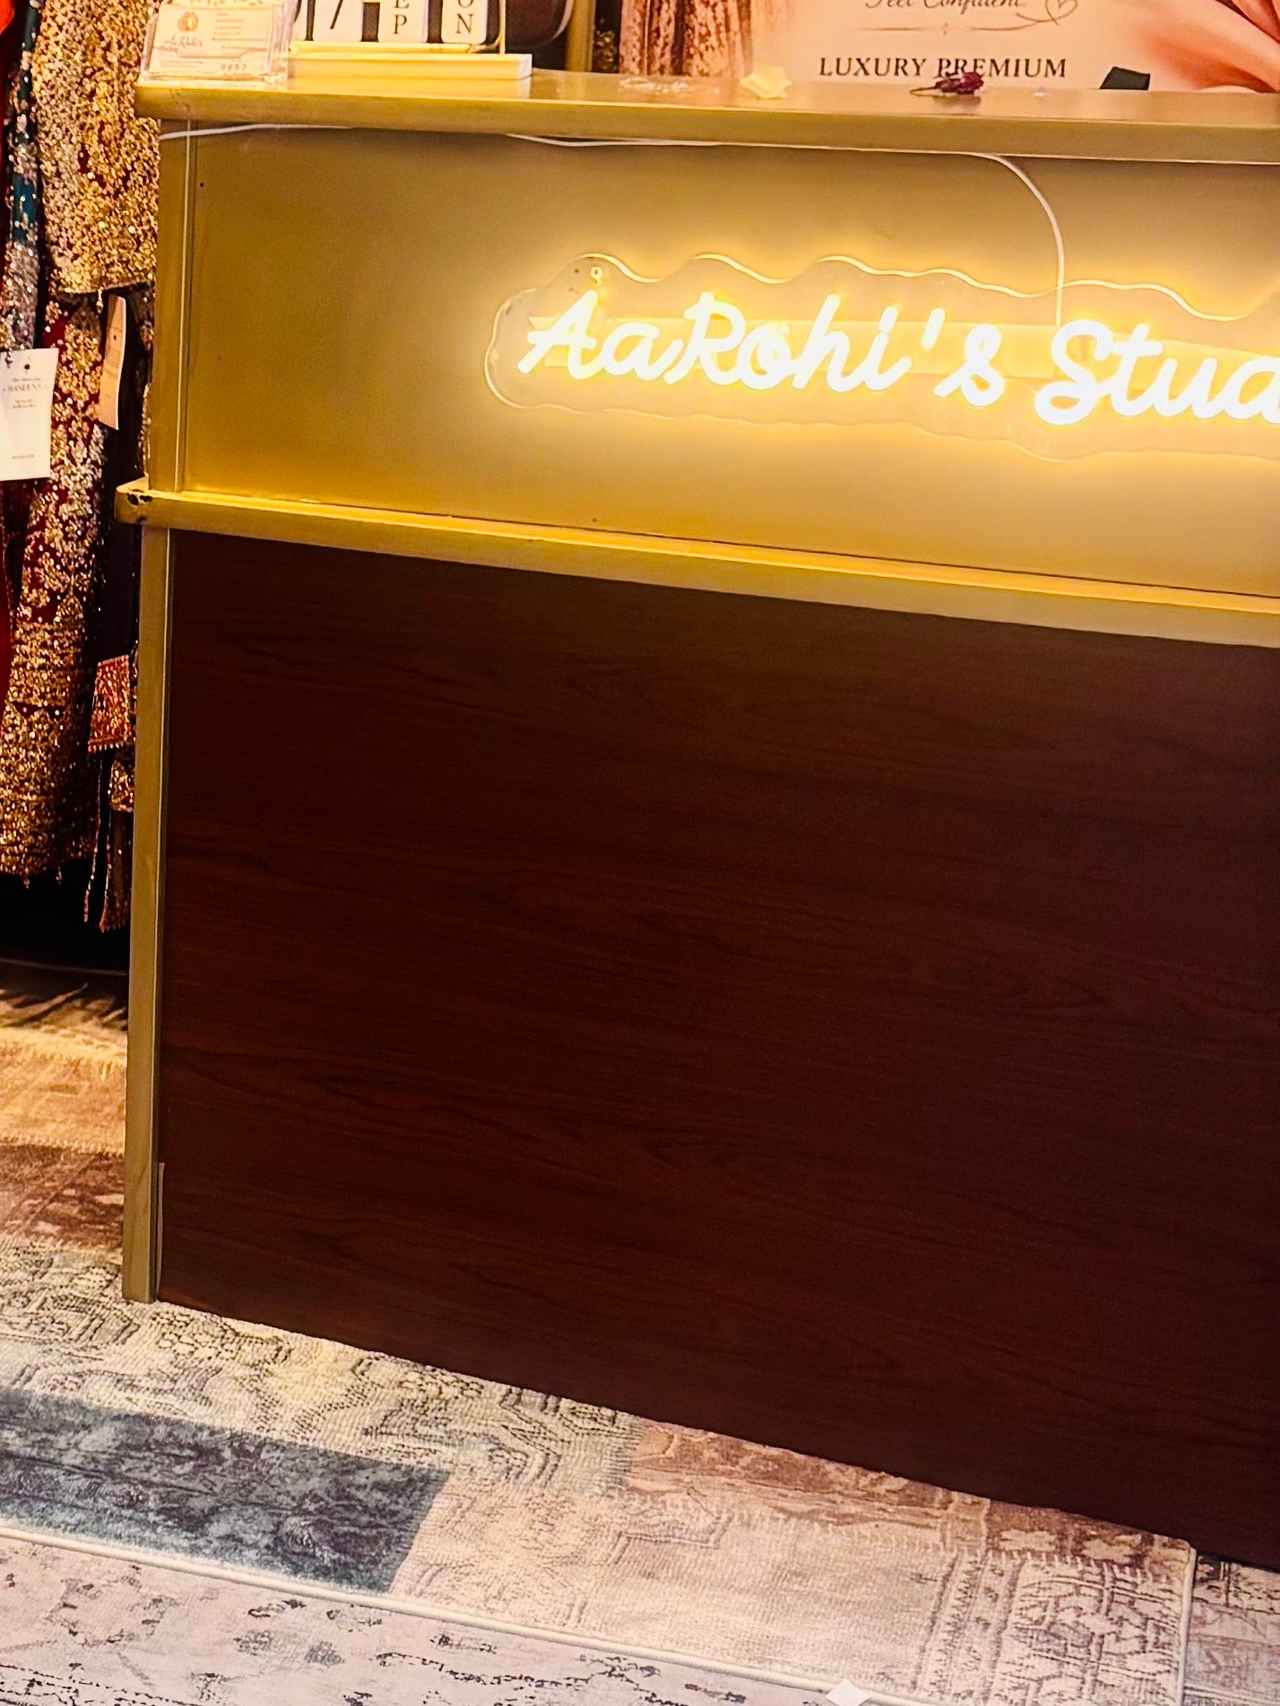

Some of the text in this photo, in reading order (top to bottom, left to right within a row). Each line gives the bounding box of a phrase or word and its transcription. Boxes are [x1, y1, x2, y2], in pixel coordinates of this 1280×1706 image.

[819, 57, 1067, 78] LUXURY PREMIUM
[517, 290, 1006, 408] AaRohi's
